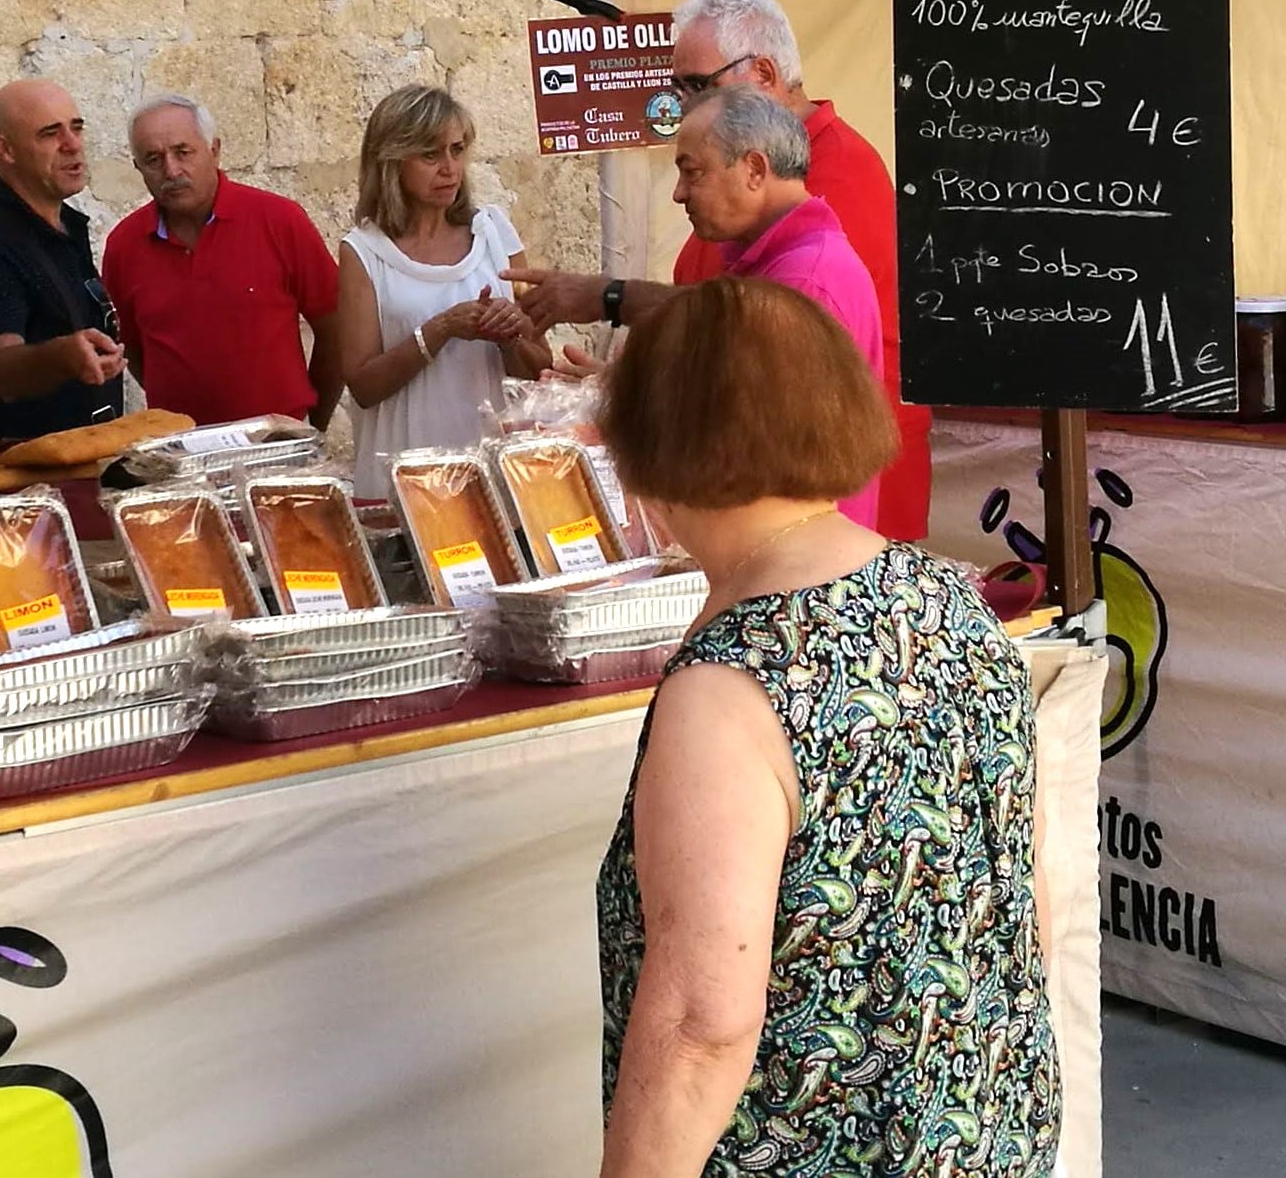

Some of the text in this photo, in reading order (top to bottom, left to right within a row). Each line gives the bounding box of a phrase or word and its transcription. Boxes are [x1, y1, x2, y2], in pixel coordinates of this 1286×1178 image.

[536, 26, 596, 55] LOMO
[602, 25, 629, 50] DE
[589, 56, 636, 70] PREMIO
[925, 61, 1106, 108] Quesadas
[584, 107, 624, 124] Casa
[585, 127, 641, 143] Tubero
[915, 290, 956, 320] 2
[555, 521, 593, 538] TURRON
[438, 546, 477, 561] TURRON
[3, 601, 54, 621] LIMON
